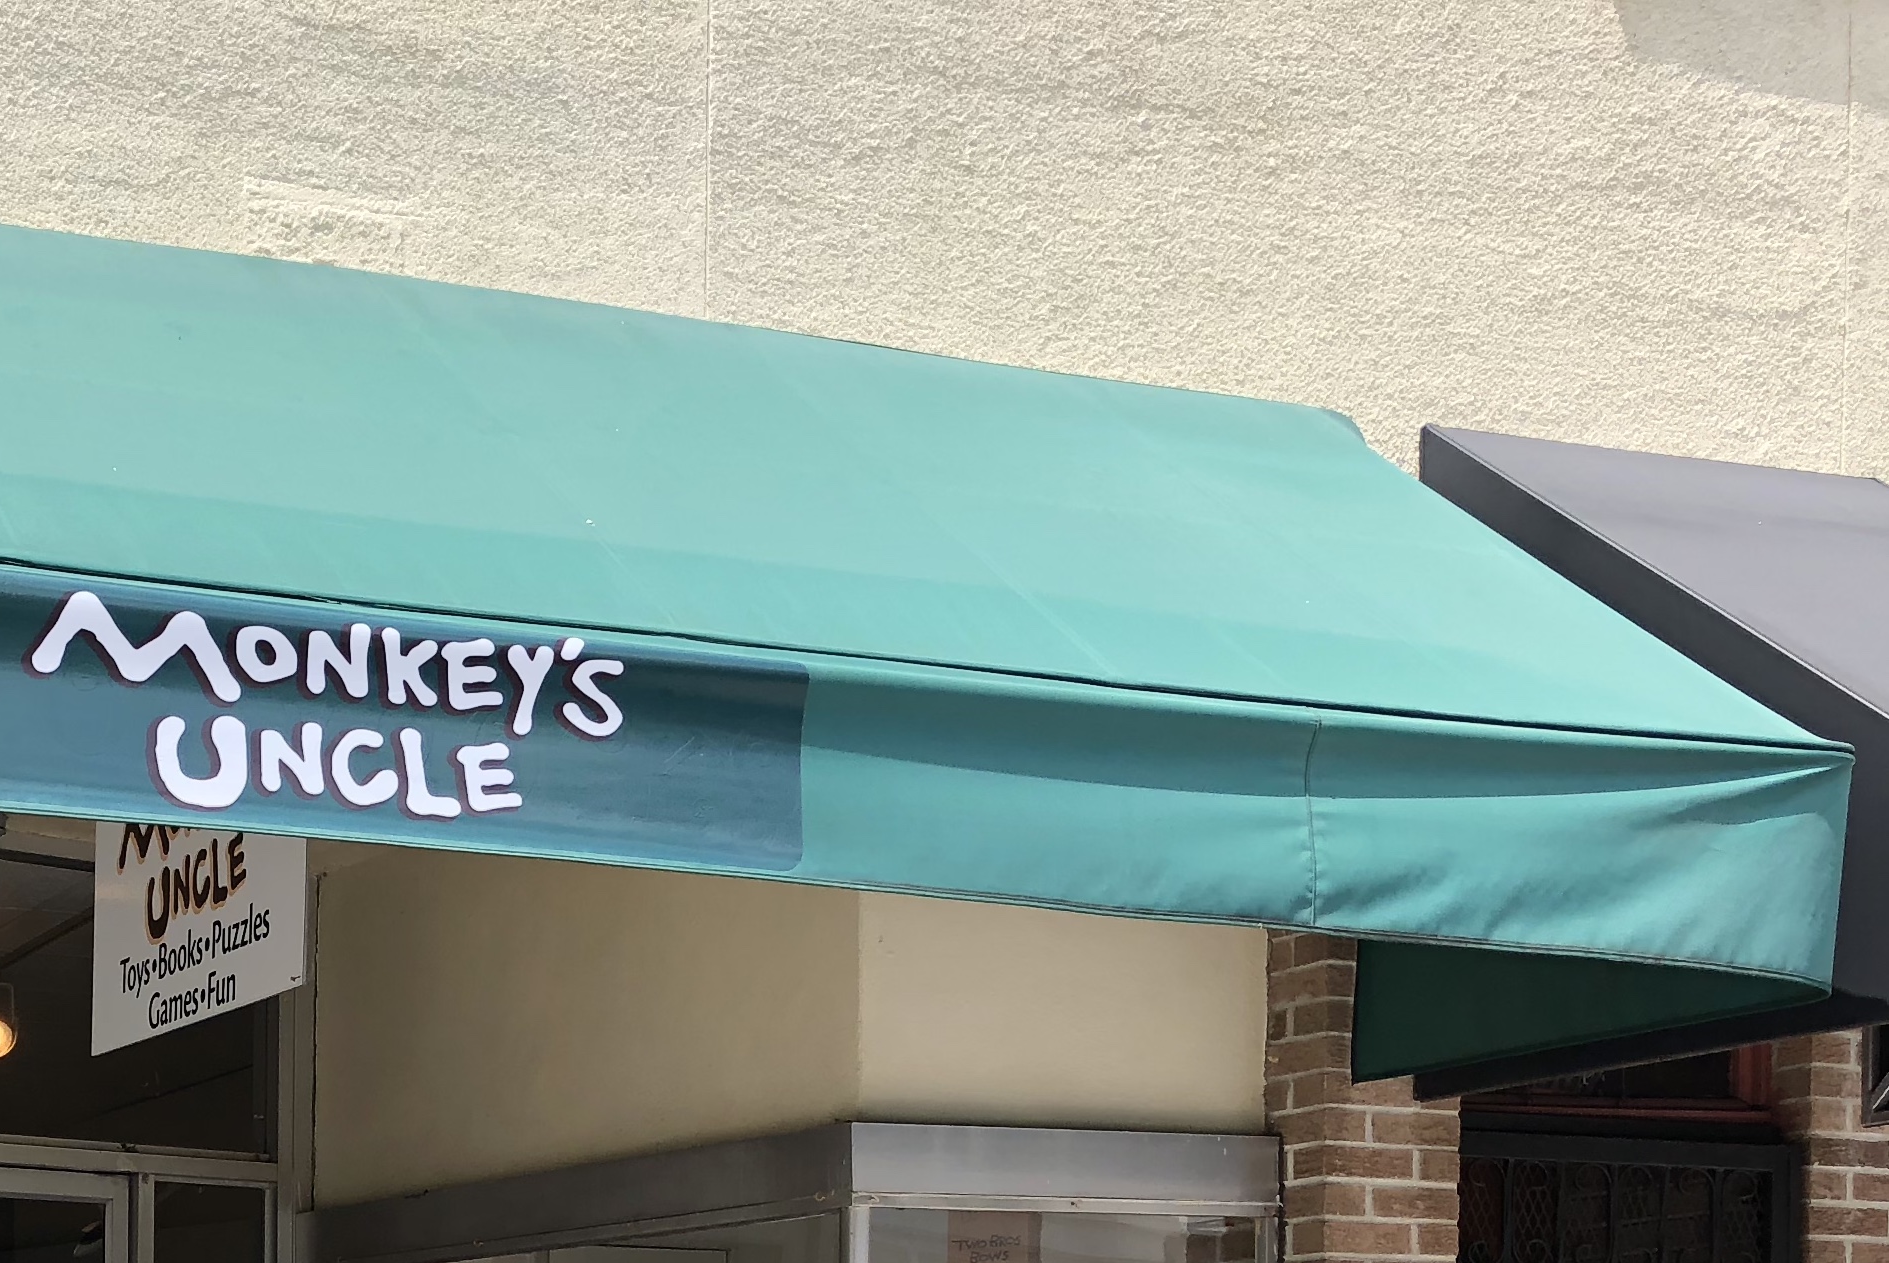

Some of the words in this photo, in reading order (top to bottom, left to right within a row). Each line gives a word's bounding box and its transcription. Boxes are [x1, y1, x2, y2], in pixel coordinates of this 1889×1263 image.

[25, 589, 625, 738] MONKEY'S
[150, 713, 524, 820] UNCLE
[144, 832, 247, 945] UNCLE
[119, 957, 151, 999] Toys
[158, 928, 204, 980] Books
[211, 902, 271, 960] Puzzles
[148, 987, 199, 1030] Games
[207, 970, 237, 1010] Fun
